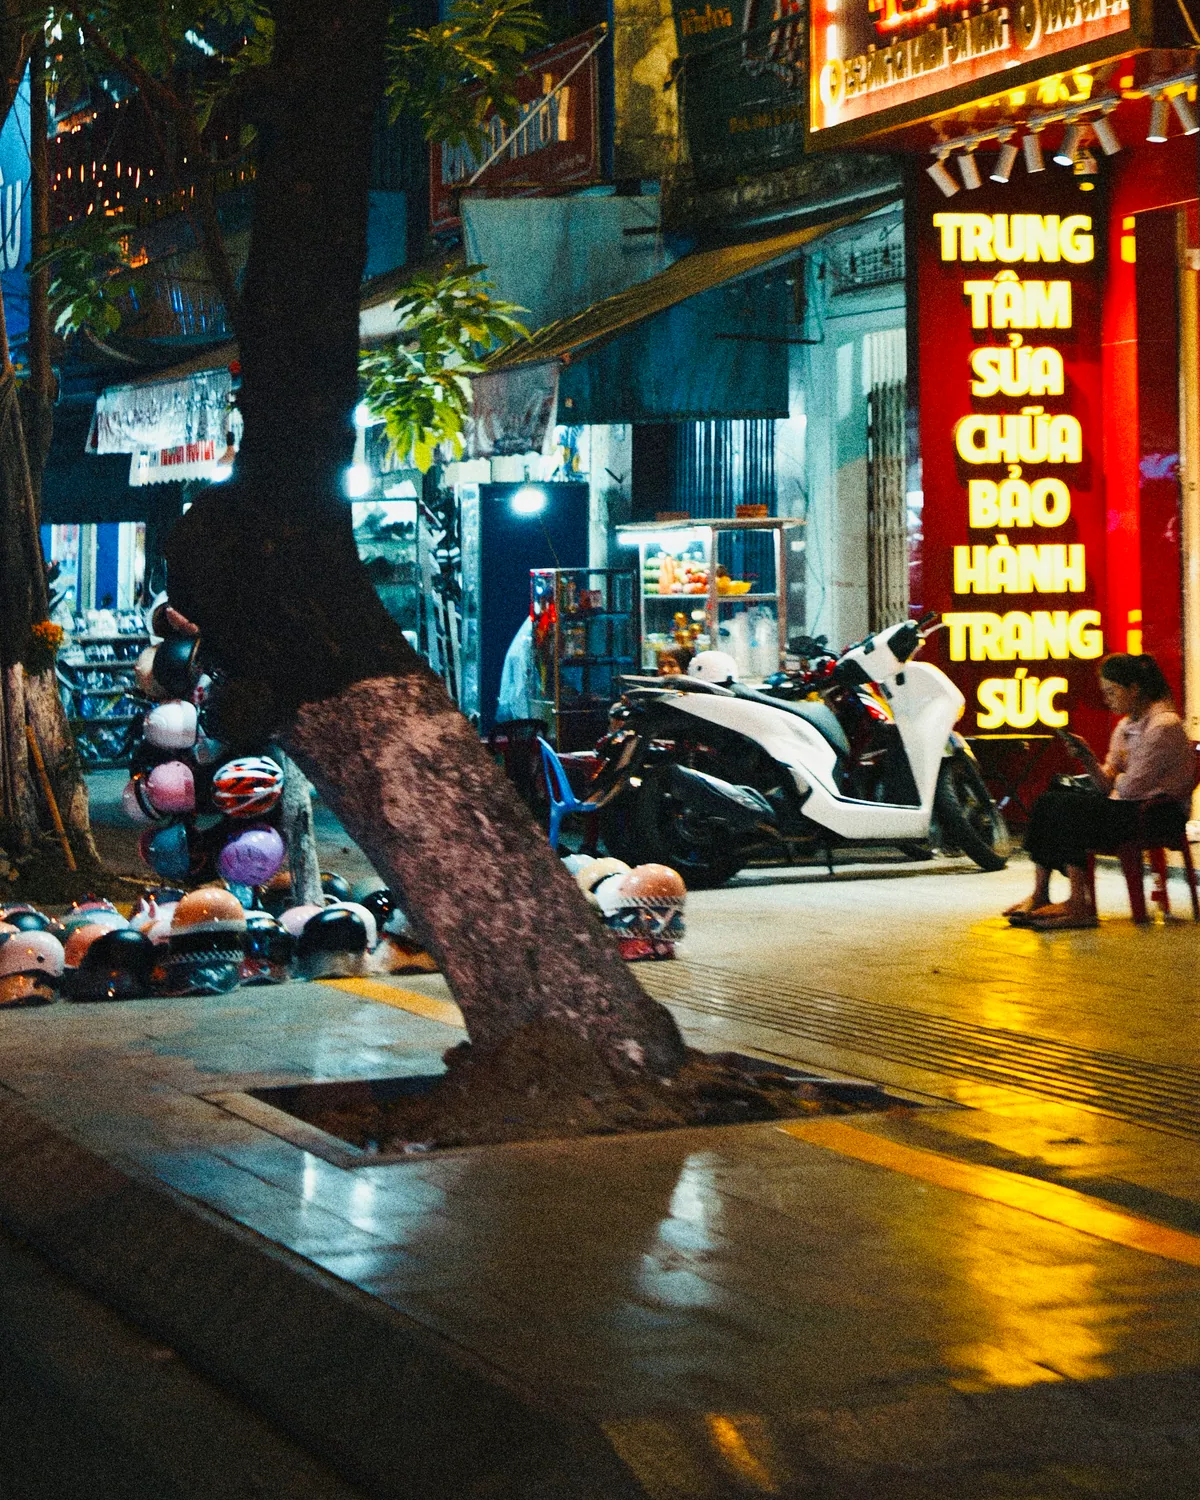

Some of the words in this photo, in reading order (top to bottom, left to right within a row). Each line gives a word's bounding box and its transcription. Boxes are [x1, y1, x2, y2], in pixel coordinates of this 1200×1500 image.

[932, 212, 1095, 263] TRUNG
[963, 269, 1072, 329] TÂM
[971, 333, 1065, 397] SỬA
[955, 405, 1083, 465] CHỮA
[968, 464, 1071, 529] BẢO
[953, 534, 1086, 595] HÀNH
[942, 609, 1103, 661] TRANG
[976, 667, 1069, 729] SỨC
